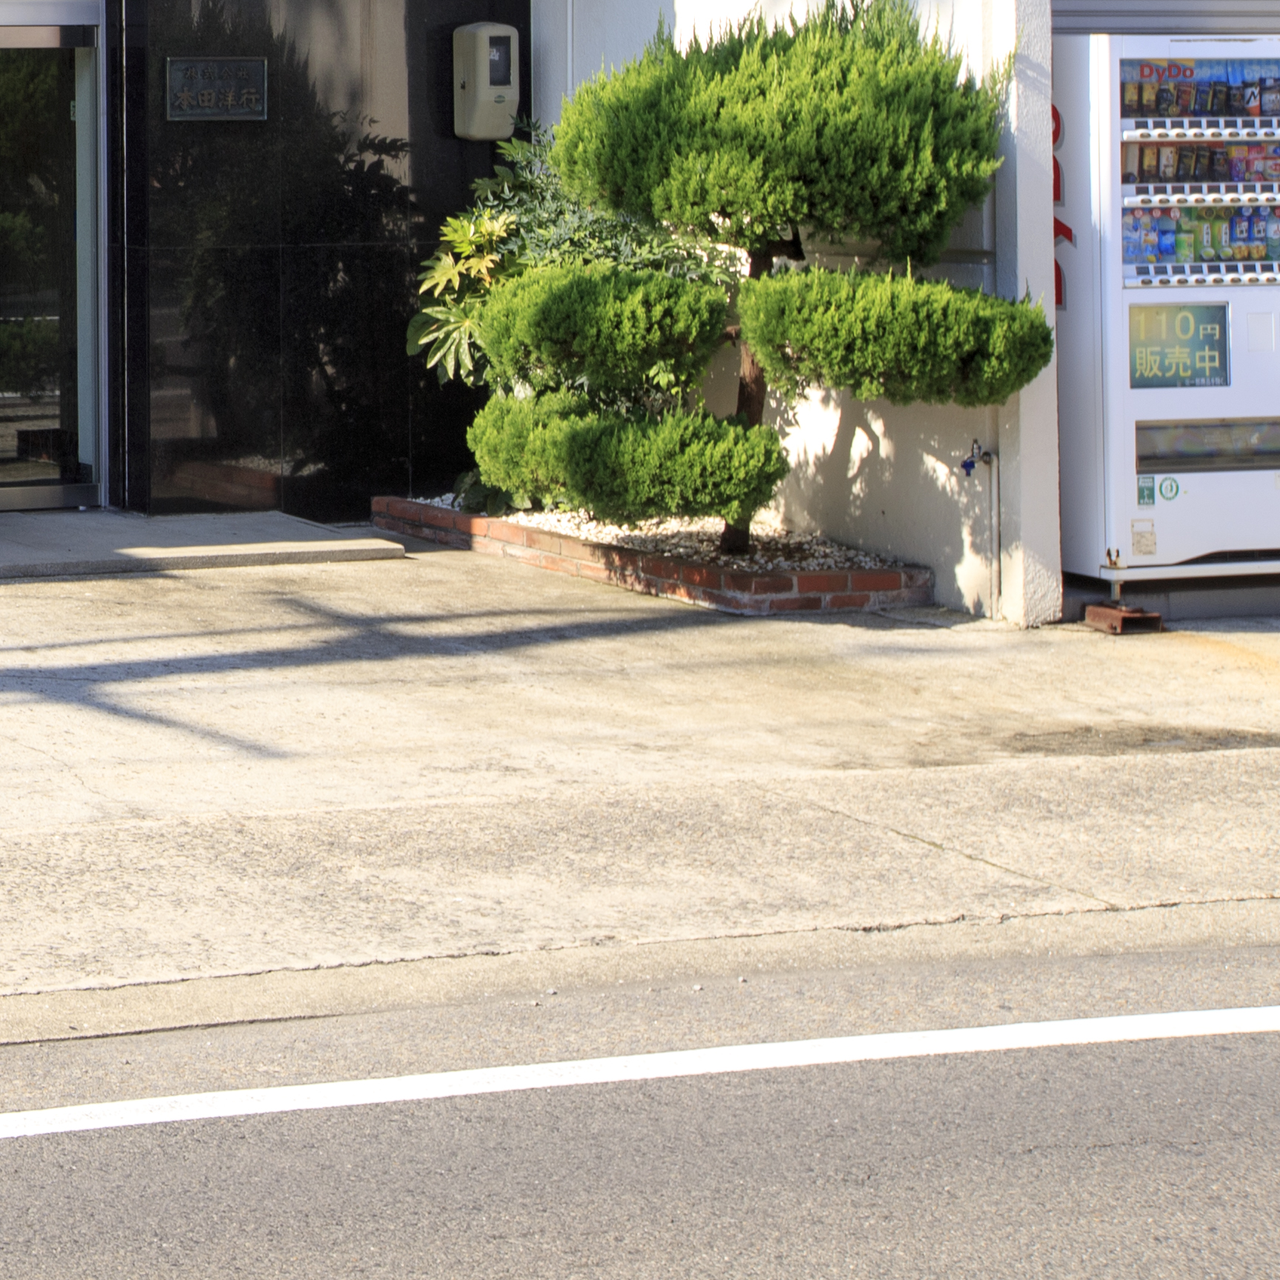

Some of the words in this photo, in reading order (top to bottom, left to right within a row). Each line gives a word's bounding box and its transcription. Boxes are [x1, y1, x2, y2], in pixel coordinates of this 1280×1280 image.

[1139, 63, 1195, 84] DyDo
[174, 87, 260, 111] 本田洋行
[1135, 345, 1220, 378] 販売中
